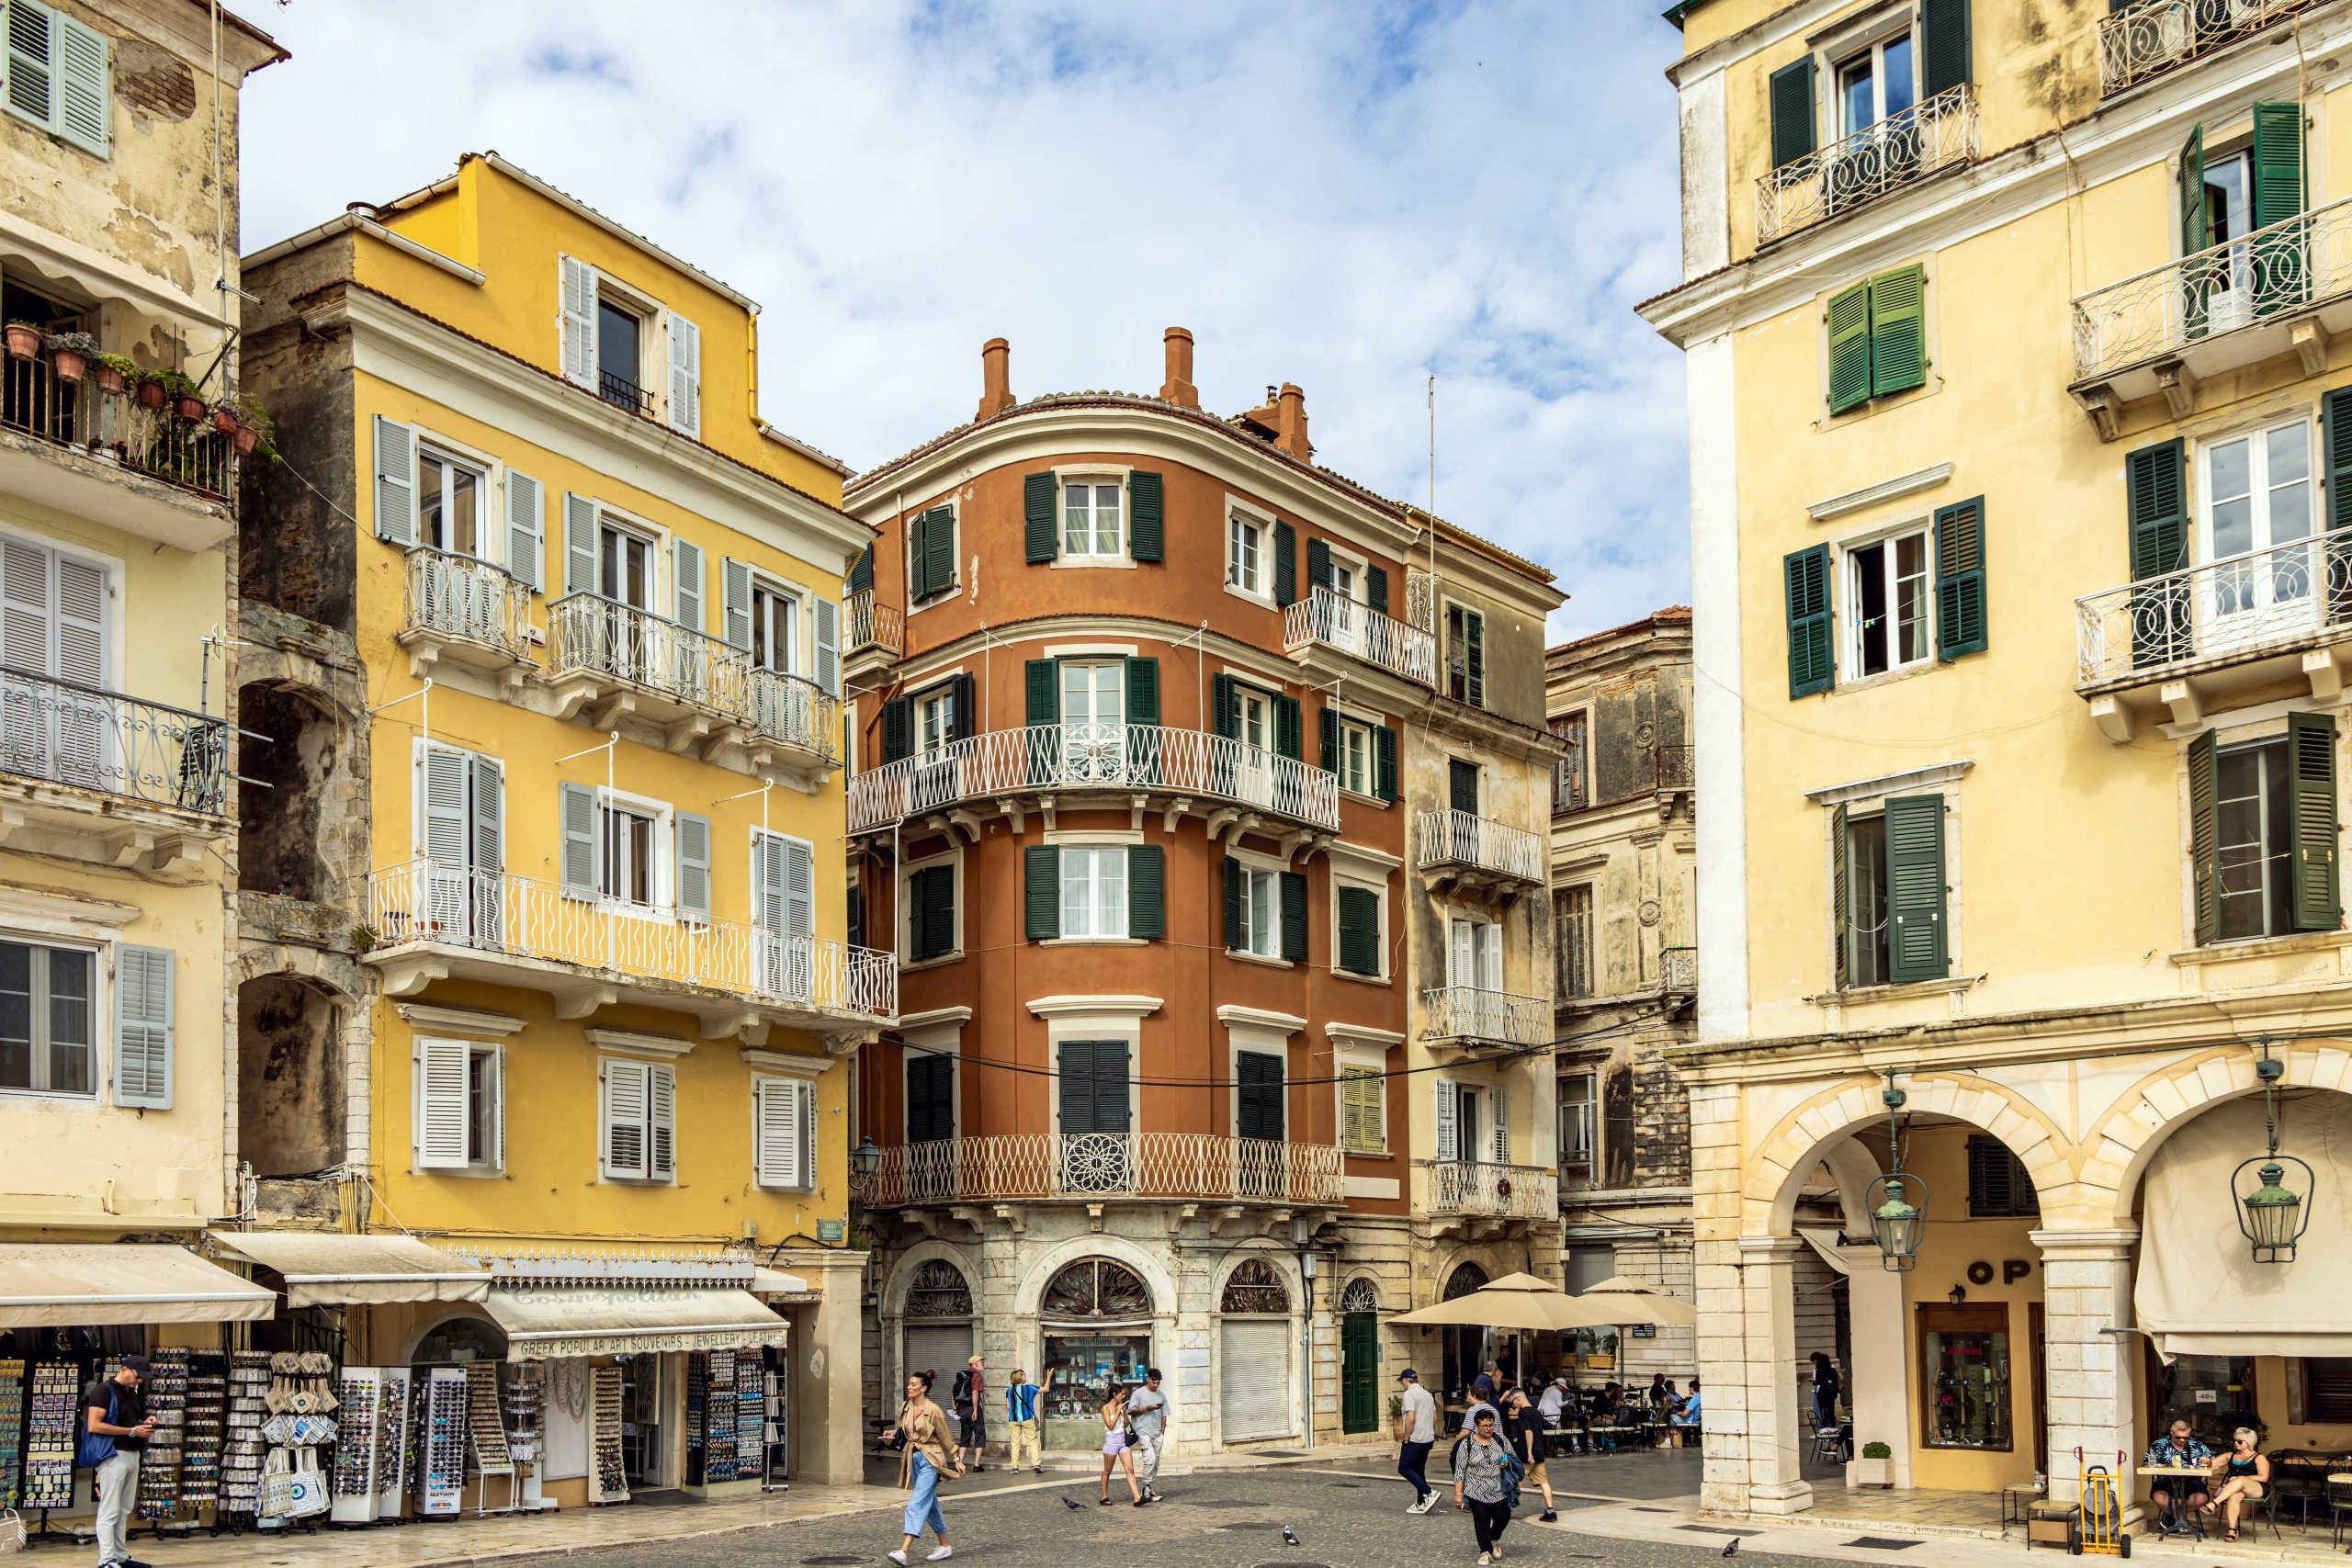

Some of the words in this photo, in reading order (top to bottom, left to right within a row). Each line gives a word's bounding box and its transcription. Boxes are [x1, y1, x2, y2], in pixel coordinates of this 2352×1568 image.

[1967, 1260, 2044, 1285] OP
[502, 1284, 701, 1305] Cosmopolitan
[521, 1340, 555, 1355] GREEK
[560, 1339, 605, 1354] POPULAR
[610, 1337, 628, 1352] ART
[631, 1336, 683, 1350] SOUVENIRS
[692, 1333, 741, 1348] JEWELLERY
[1079, 1337, 1113, 1346] Marlboro
